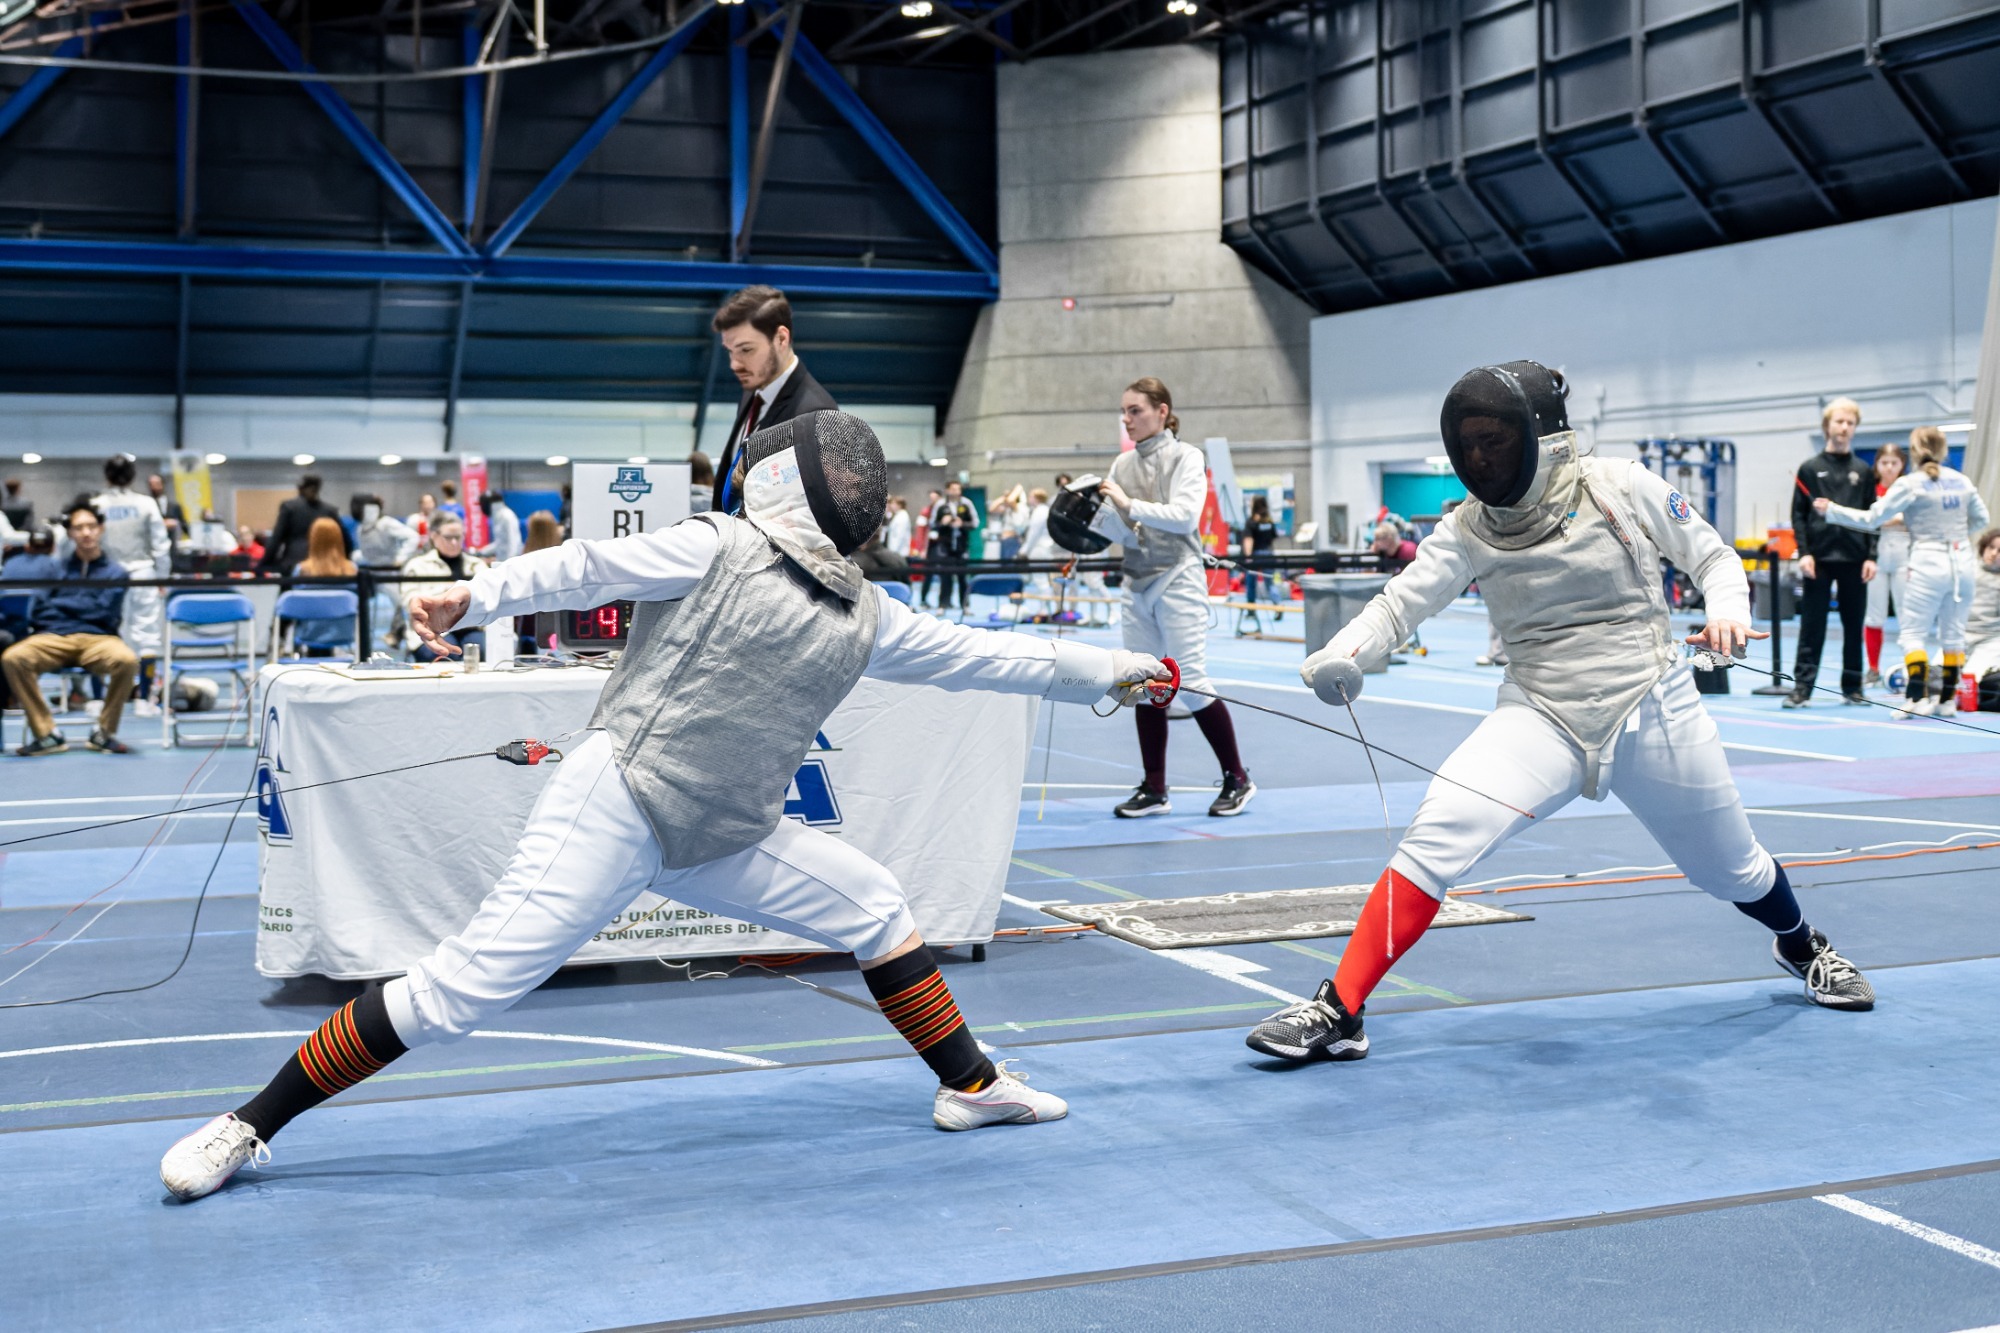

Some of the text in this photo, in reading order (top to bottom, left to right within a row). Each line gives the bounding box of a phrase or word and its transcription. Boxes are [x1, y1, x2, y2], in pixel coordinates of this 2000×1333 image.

[599, 608, 618, 637] 4
[629, 909, 721, 922] UNIVERSI
[607, 923, 733, 941] UNIVERSITAIRES
[738, 923, 757, 934] DE
